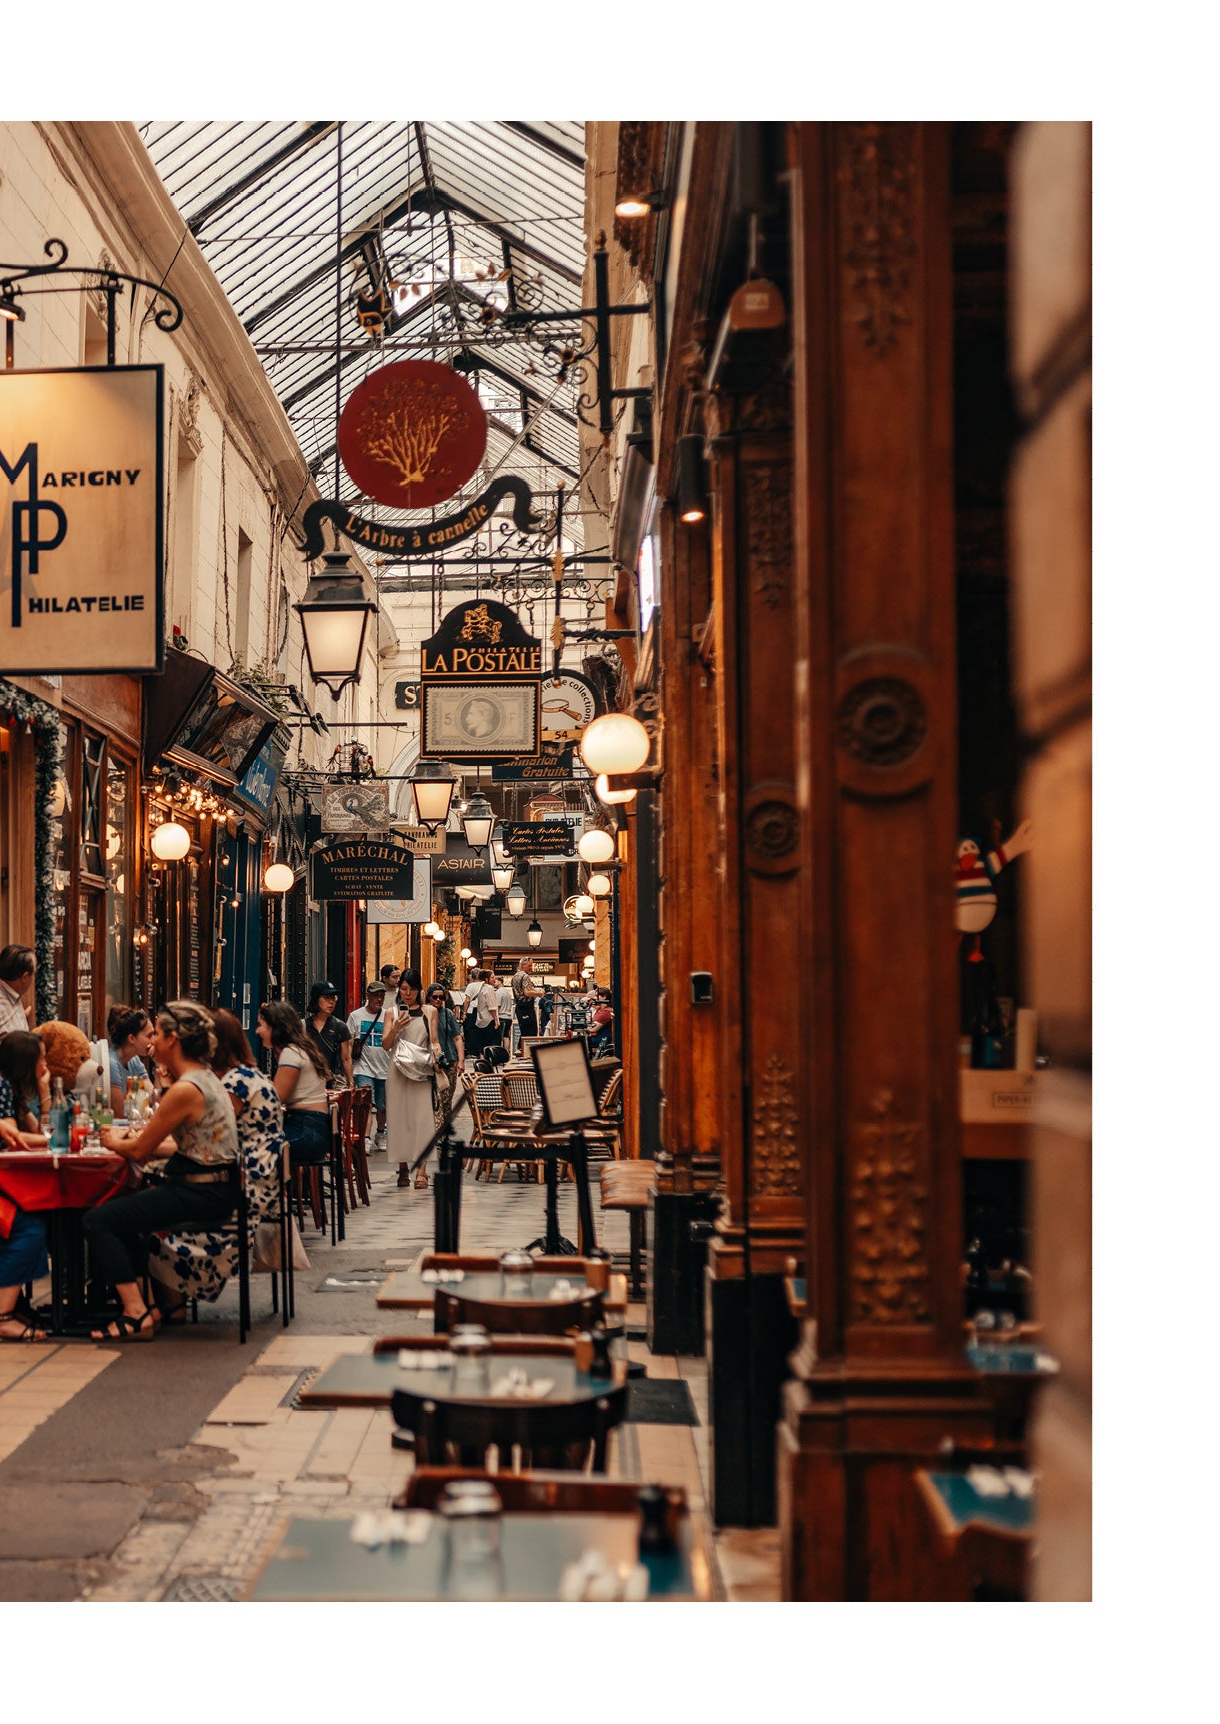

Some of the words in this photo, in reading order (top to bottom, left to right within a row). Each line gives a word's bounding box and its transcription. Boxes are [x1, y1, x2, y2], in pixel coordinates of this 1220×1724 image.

[344, 514, 404, 548] L'Arbre
[412, 530, 422, 548] à
[429, 503, 489, 545] cannelle
[421, 649, 448, 671] LA
[453, 648, 540, 671] POSTALE
[569, 681, 593, 724] collections
[555, 730, 568, 739] 54
[522, 767, 570, 777] Gratuite
[322, 842, 408, 866] MARÉCHAL
[438, 859, 485, 869] ASTAIR
